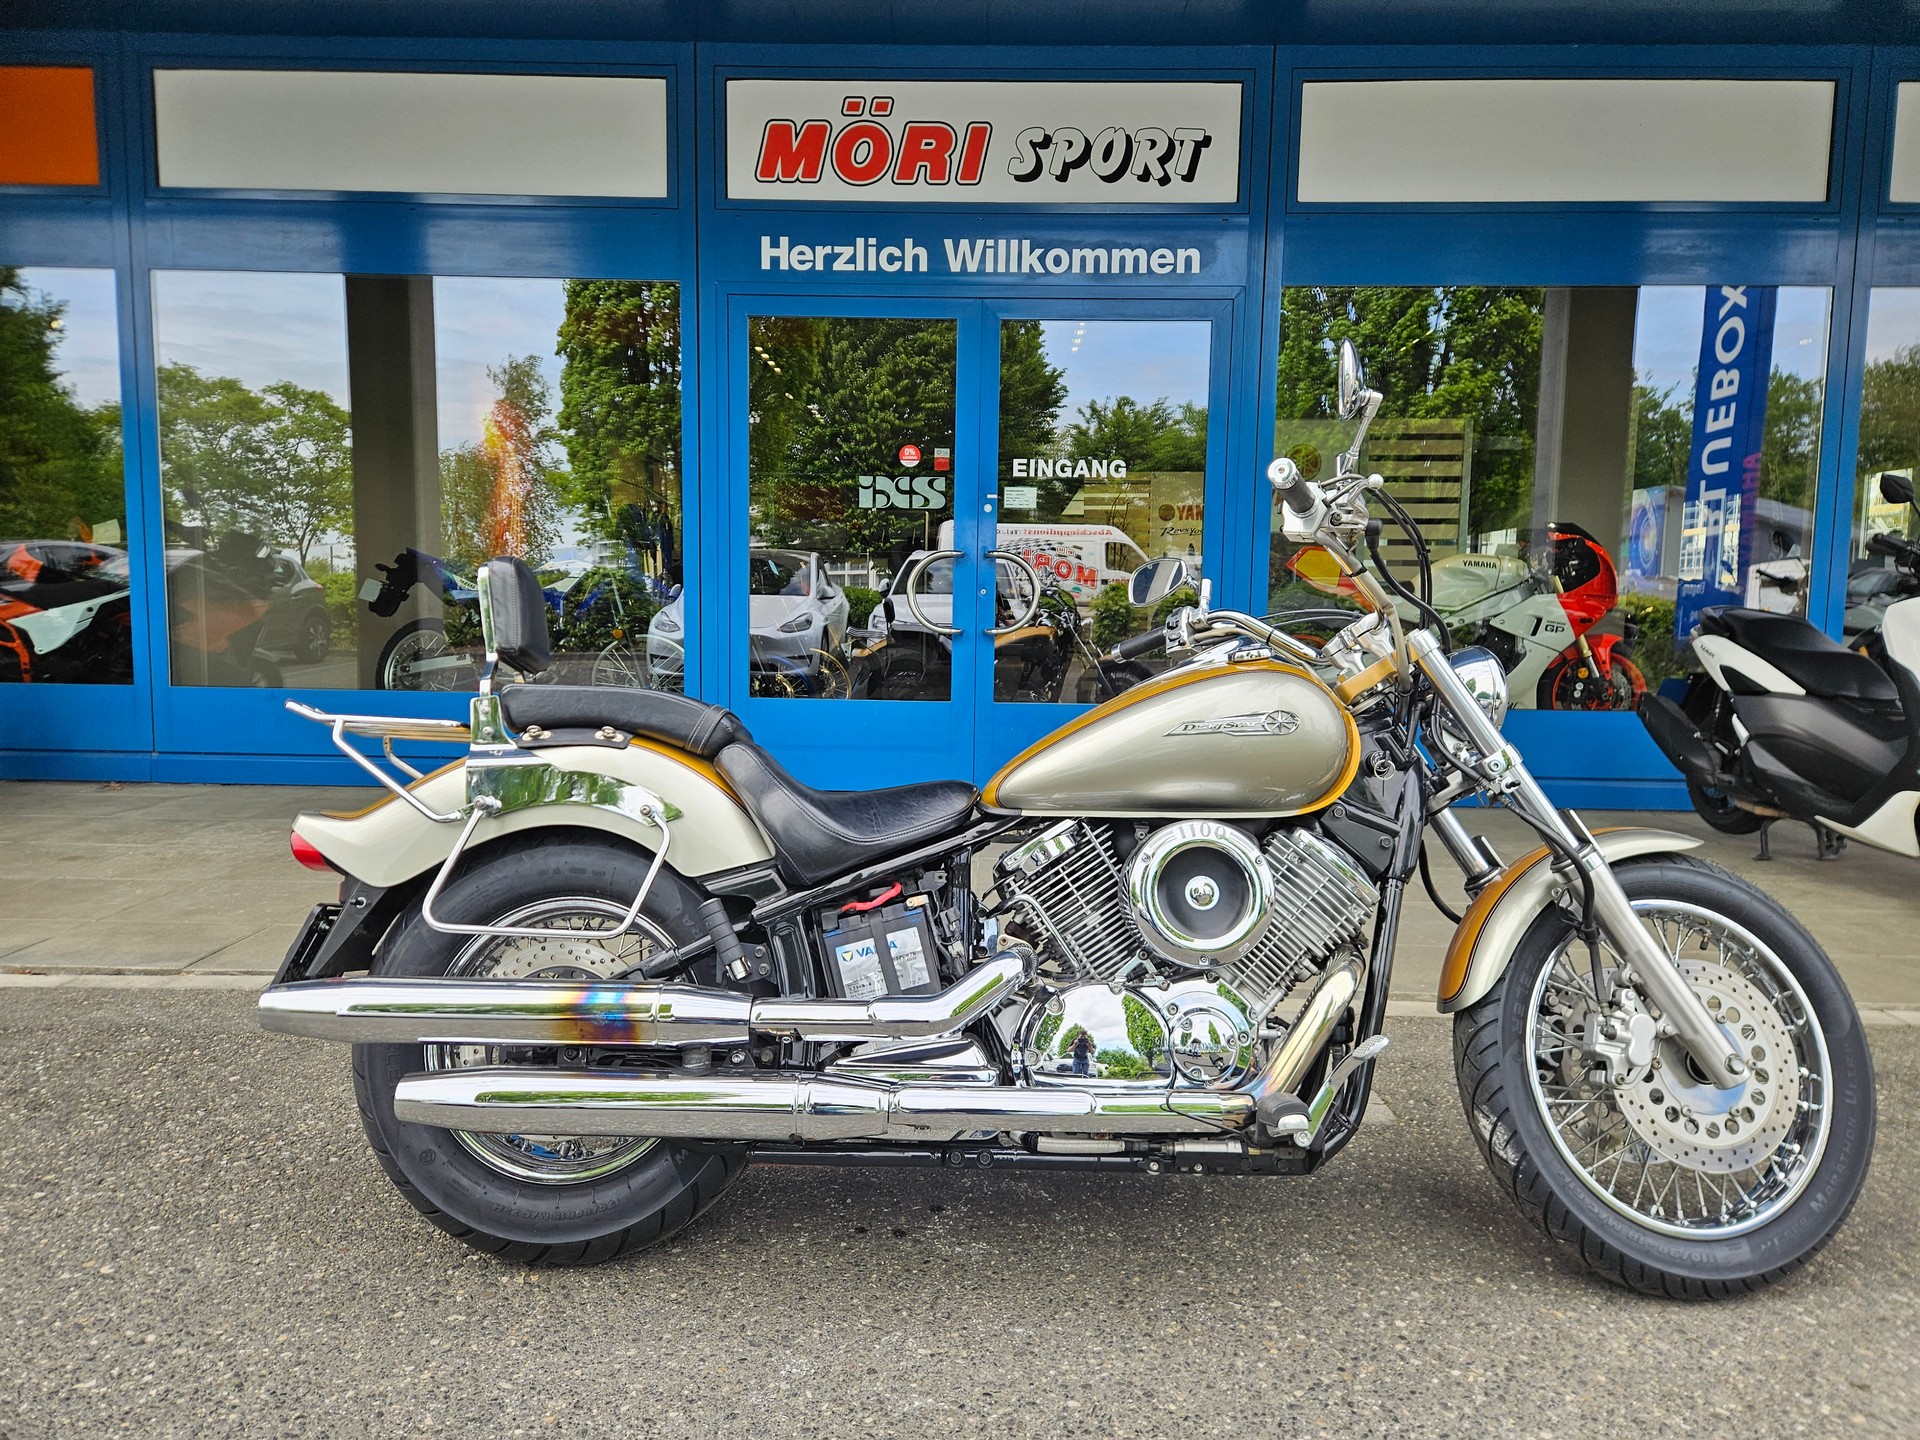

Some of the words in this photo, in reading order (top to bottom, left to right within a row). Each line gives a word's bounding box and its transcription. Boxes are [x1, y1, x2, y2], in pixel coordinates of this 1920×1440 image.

[755, 96, 992, 187] MÖRI
[1007, 127, 1212, 187] SPORT
[760, 235, 928, 273] Herzlich
[943, 238, 1201, 275] Willkommen
[1012, 458, 1127, 478] EINGANG
[1463, 560, 1498, 570] YAMAHA
[1545, 624, 1565, 634] GP
[1178, 821, 1227, 840] 1100
